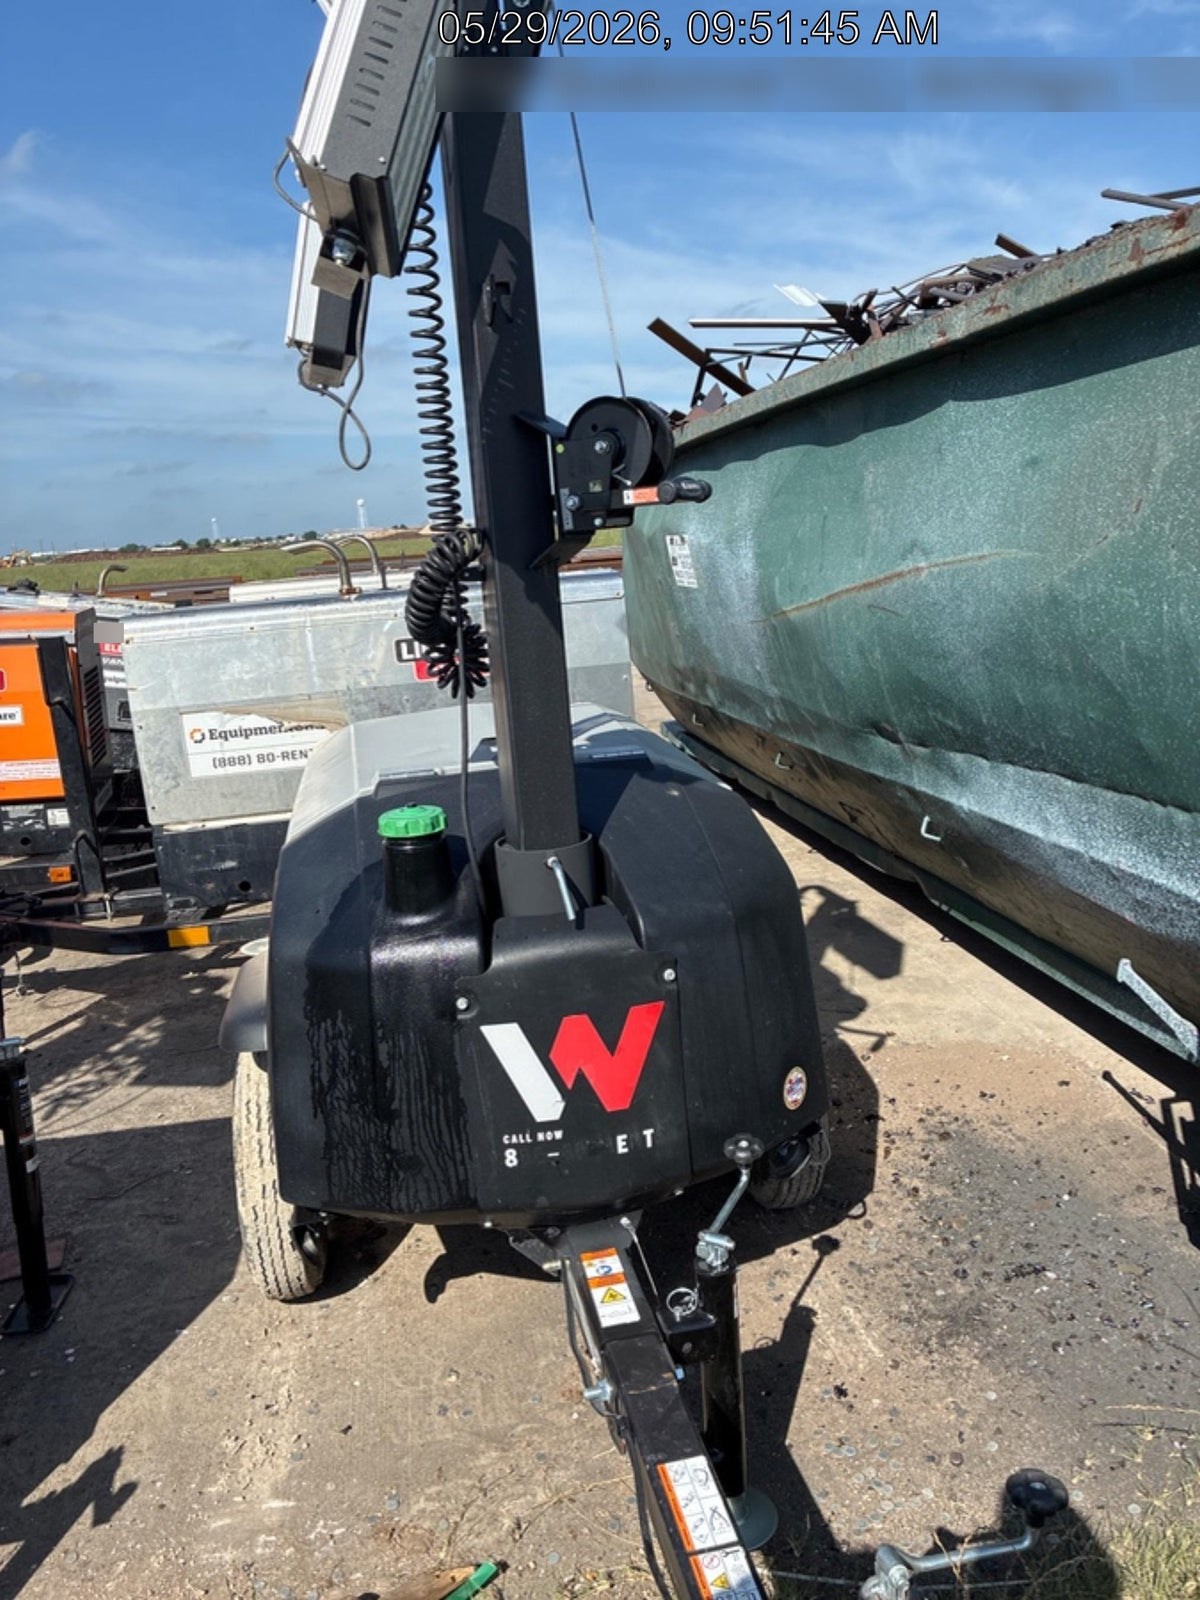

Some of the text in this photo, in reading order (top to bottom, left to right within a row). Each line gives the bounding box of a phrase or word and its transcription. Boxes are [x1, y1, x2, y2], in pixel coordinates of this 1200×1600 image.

[212, 754, 252, 769] (888)
[502, 1130, 563, 1144] CALL NOW
